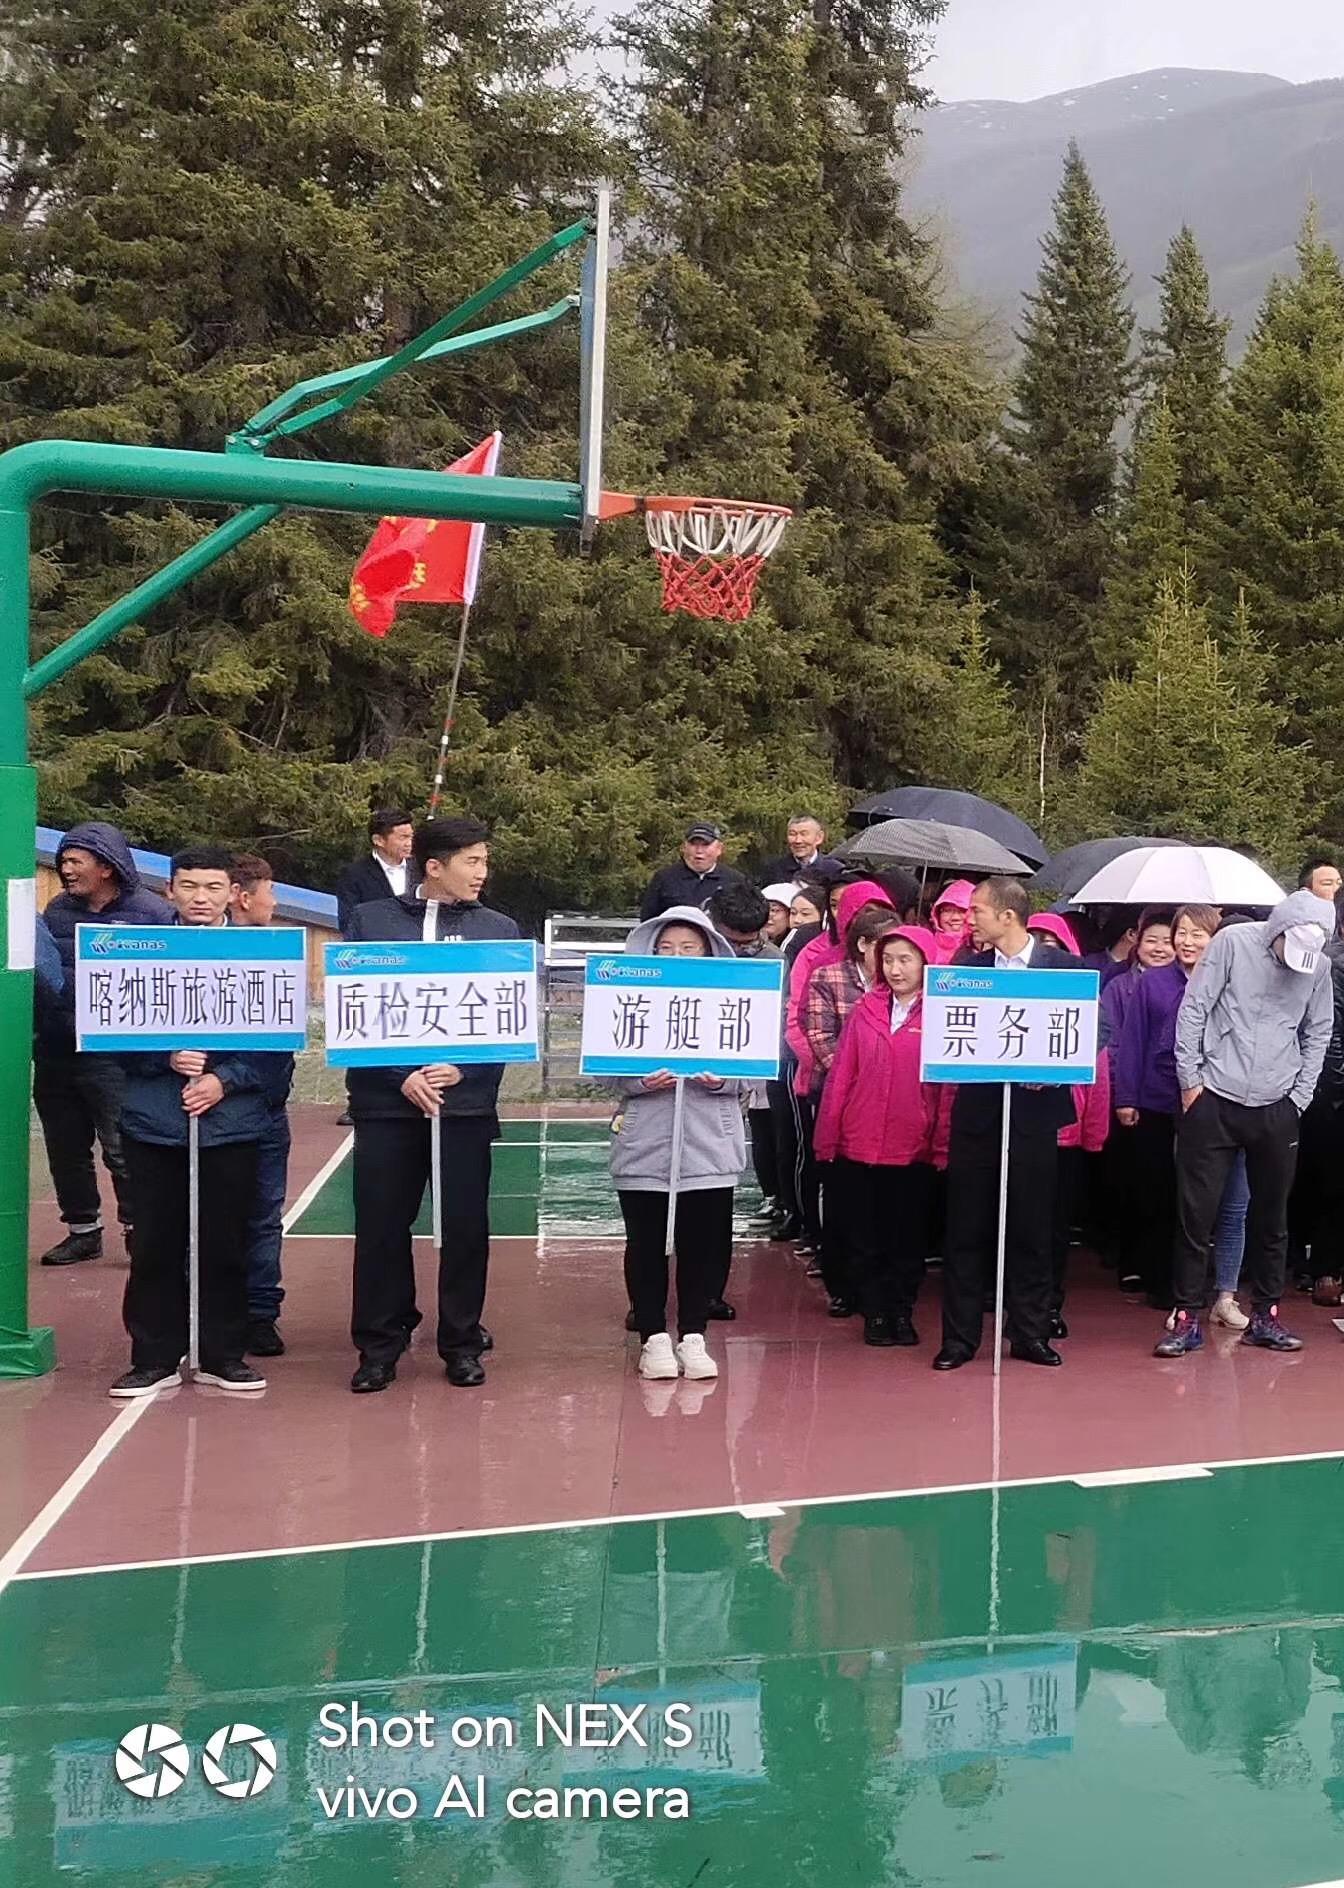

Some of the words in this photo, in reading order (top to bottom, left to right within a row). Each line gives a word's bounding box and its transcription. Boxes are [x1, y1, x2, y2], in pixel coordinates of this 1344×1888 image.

[88, 967, 296, 1027] 喀纳斯旅游酒店
[335, 979, 528, 1041] 质检安全部
[612, 993, 751, 1052] 游艇部
[943, 1004, 1081, 1060] 票务部
